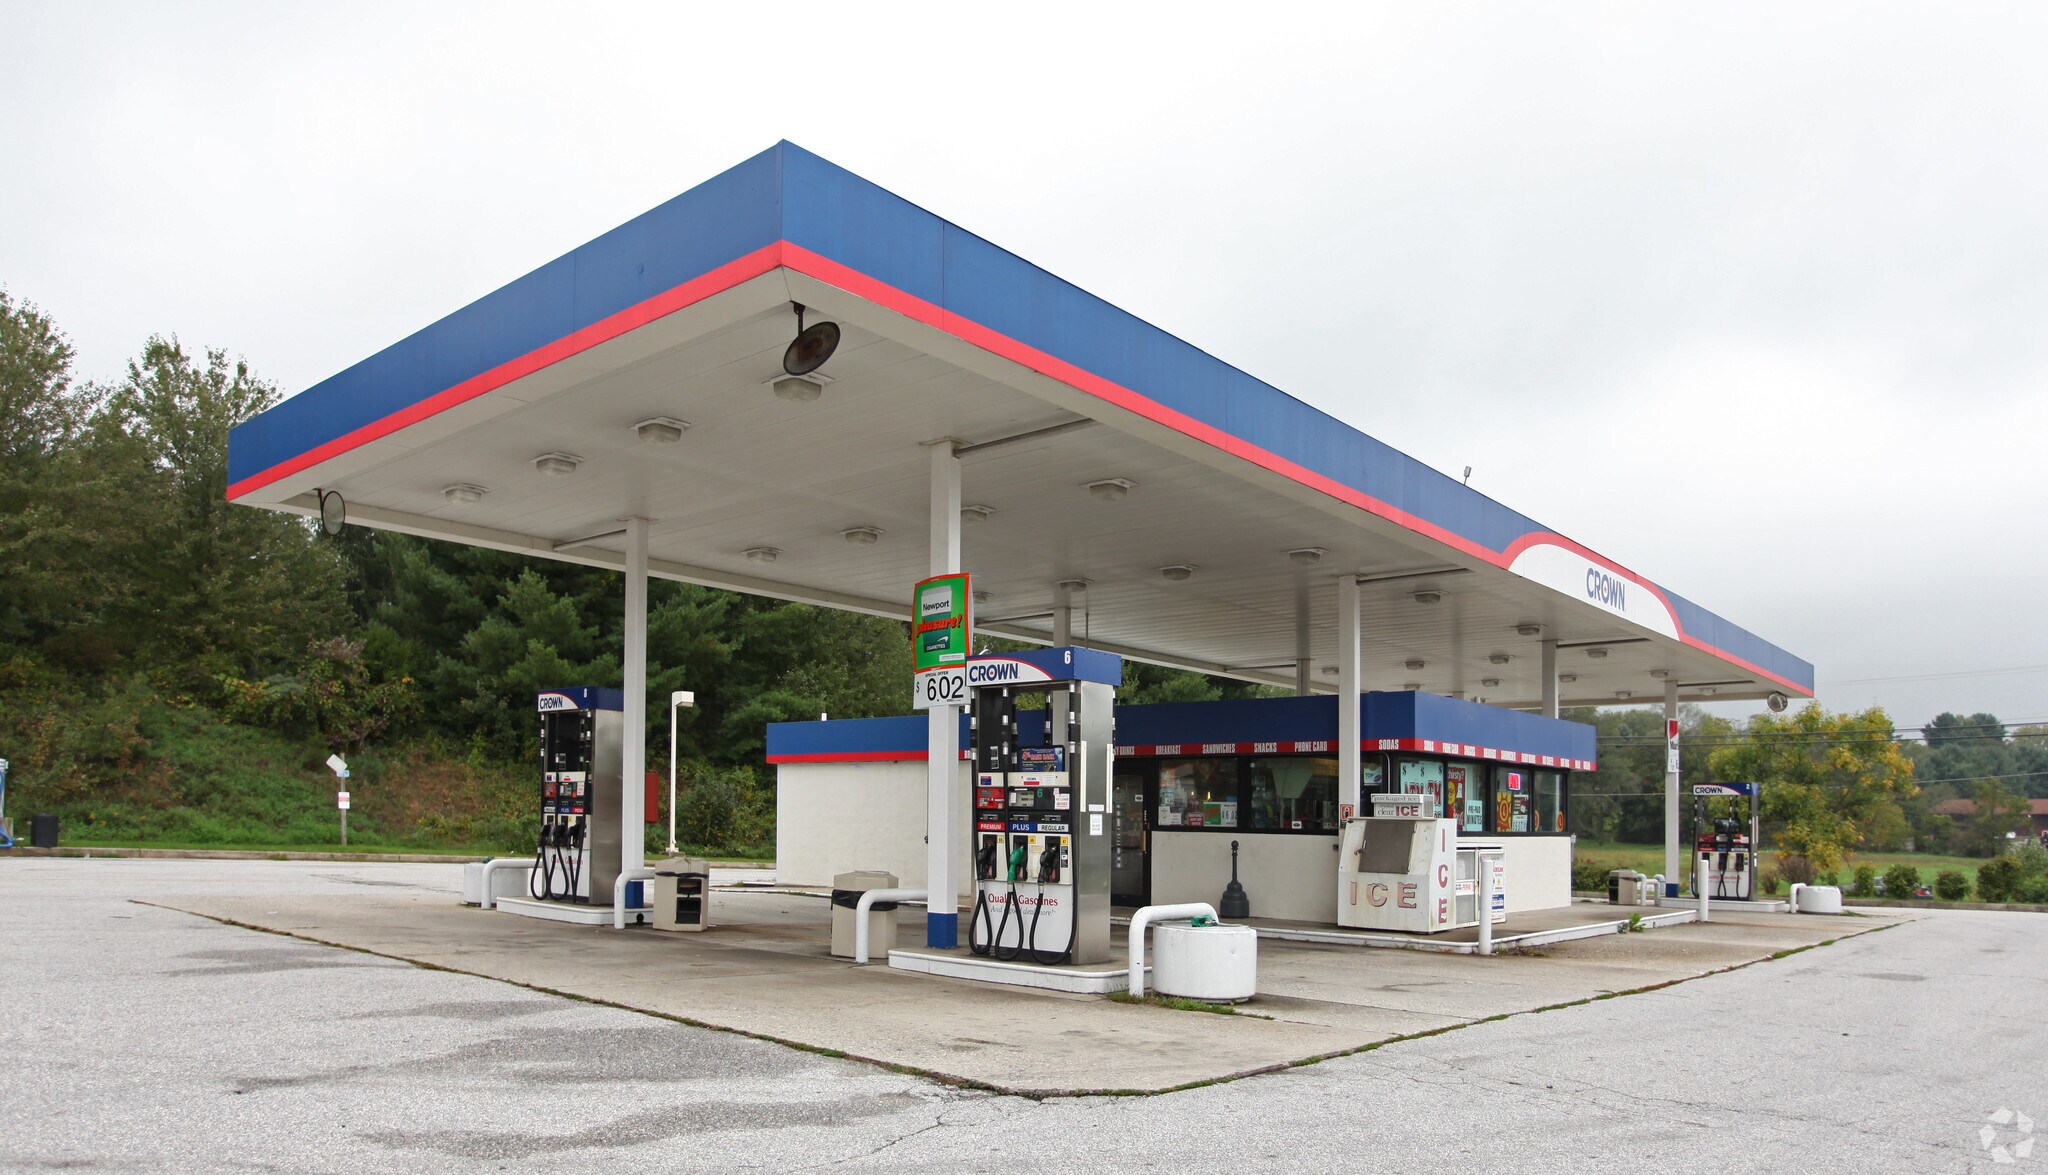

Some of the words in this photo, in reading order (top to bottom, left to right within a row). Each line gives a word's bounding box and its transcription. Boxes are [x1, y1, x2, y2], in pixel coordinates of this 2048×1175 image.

[1586, 567, 1626, 612] CROWN
[923, 600, 950, 612] Newport
[1064, 650, 1071, 665] 6
[969, 662, 1019, 683] CROWN
[927, 675, 964, 702] 6.02
[540, 696, 563, 710] CROWN
[1155, 744, 1181, 756] BREAKFAST
[1202, 743, 1236, 754] SANDWICHES
[1253, 742, 1278, 753] SNACKS
[1294, 741, 1312, 752] PHONE
[1312, 741, 1328, 752] CARD
[1378, 739, 1399, 750] SODAS
[1036, 787, 1044, 798] 6
[1695, 786, 1723, 794] CROWN
[1377, 808, 1394, 816] clear
[1395, 805, 1419, 817] ICE
[1012, 823, 1030, 831] PLUS
[1041, 824, 1065, 832] REGULAR
[1350, 881, 1418, 909] ICE
